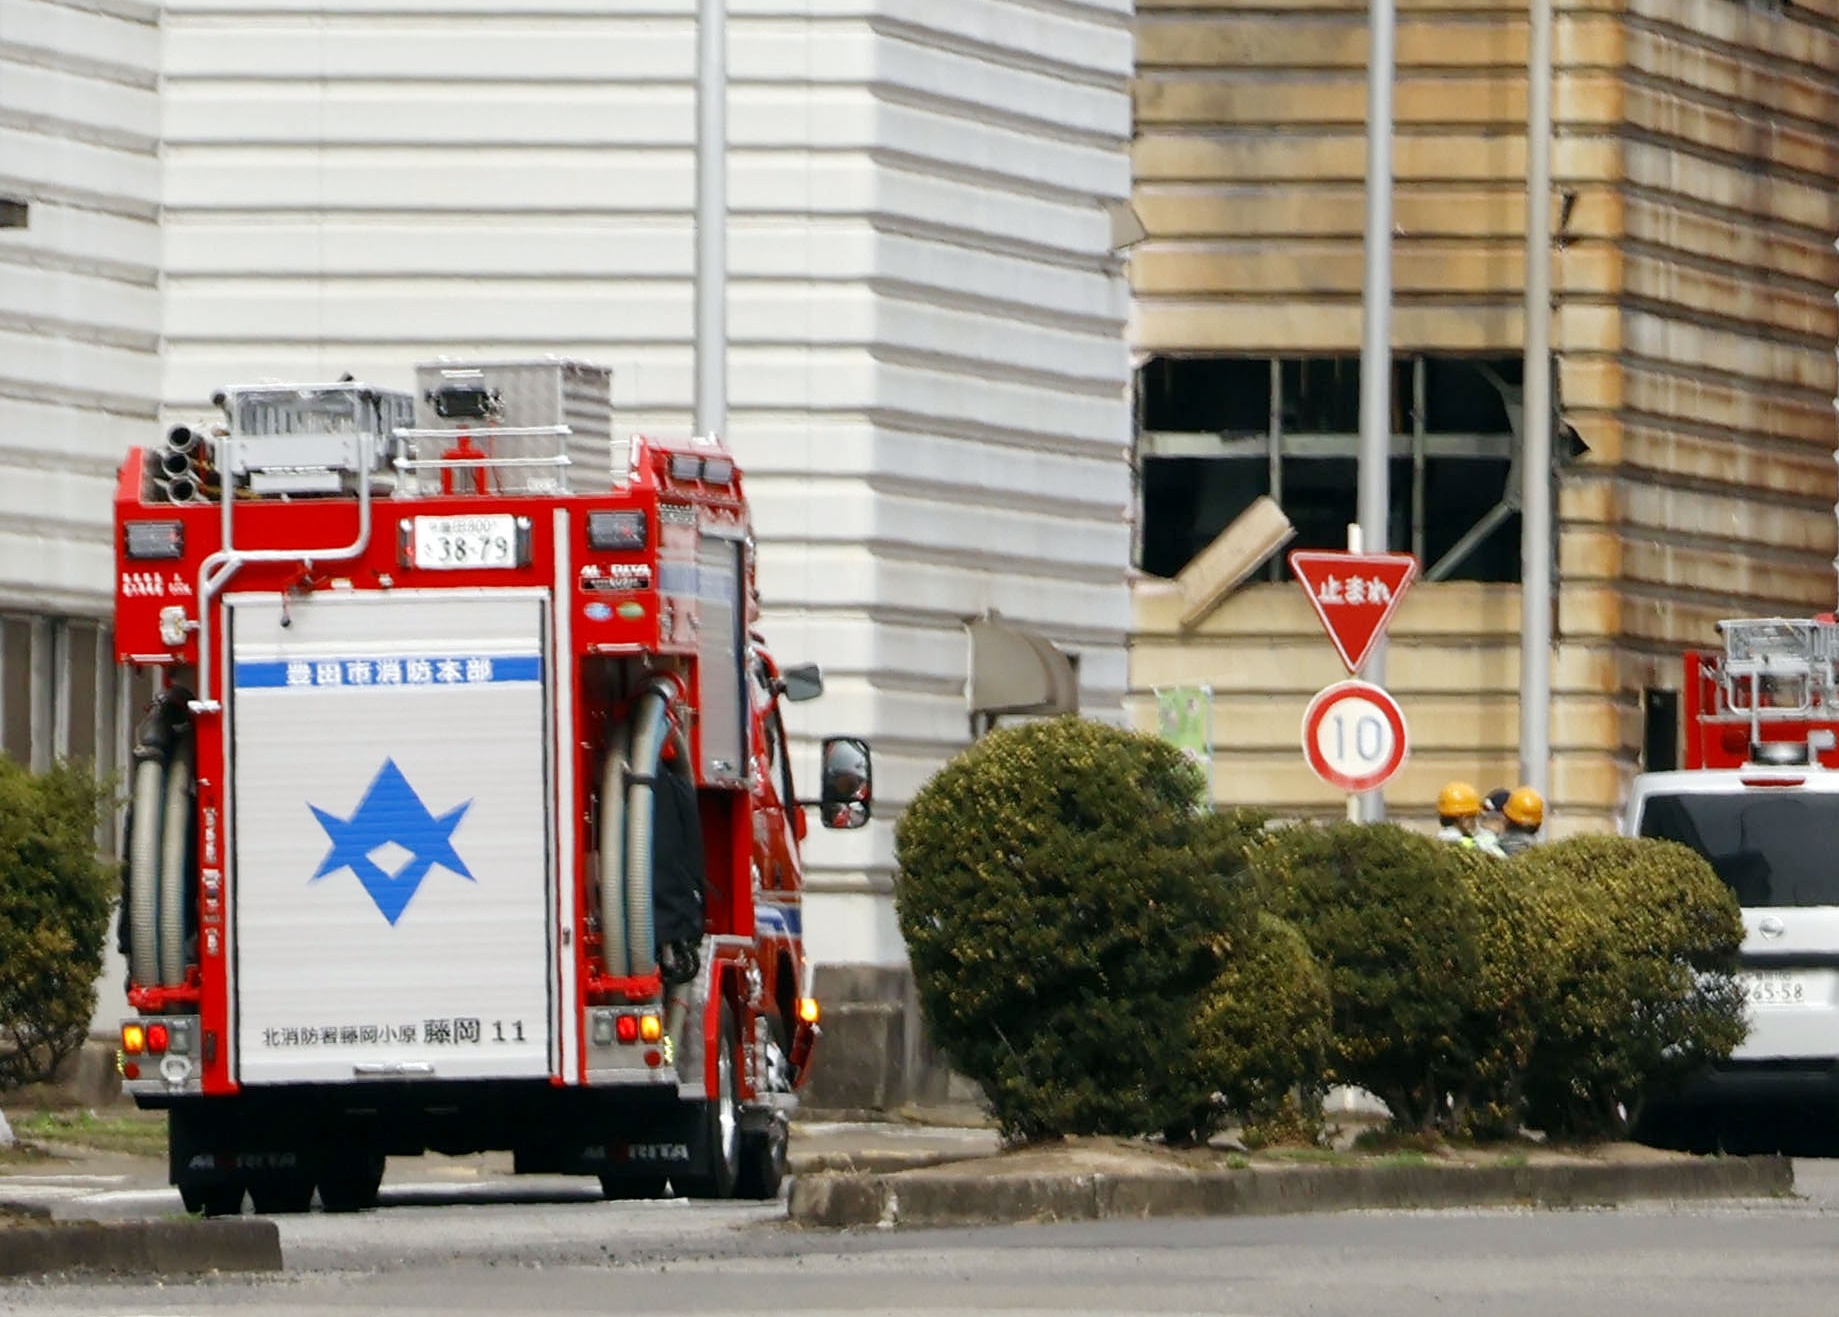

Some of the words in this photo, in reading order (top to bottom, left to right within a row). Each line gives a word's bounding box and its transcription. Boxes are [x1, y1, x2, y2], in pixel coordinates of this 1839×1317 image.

[581, 564, 651, 577] MRITA
[1318, 573, 1392, 605] 止まれ
[286, 657, 493, 687] 豊田市消防本部
[1333, 714, 1382, 761] 10
[1752, 982, 1804, 1000] 65-58
[262, 1024, 417, 1047] 北消防署藤岡小原
[422, 1017, 482, 1046] 藤岡
[490, 1019, 527, 1044] 11
[582, 1144, 690, 1160] MRITA
